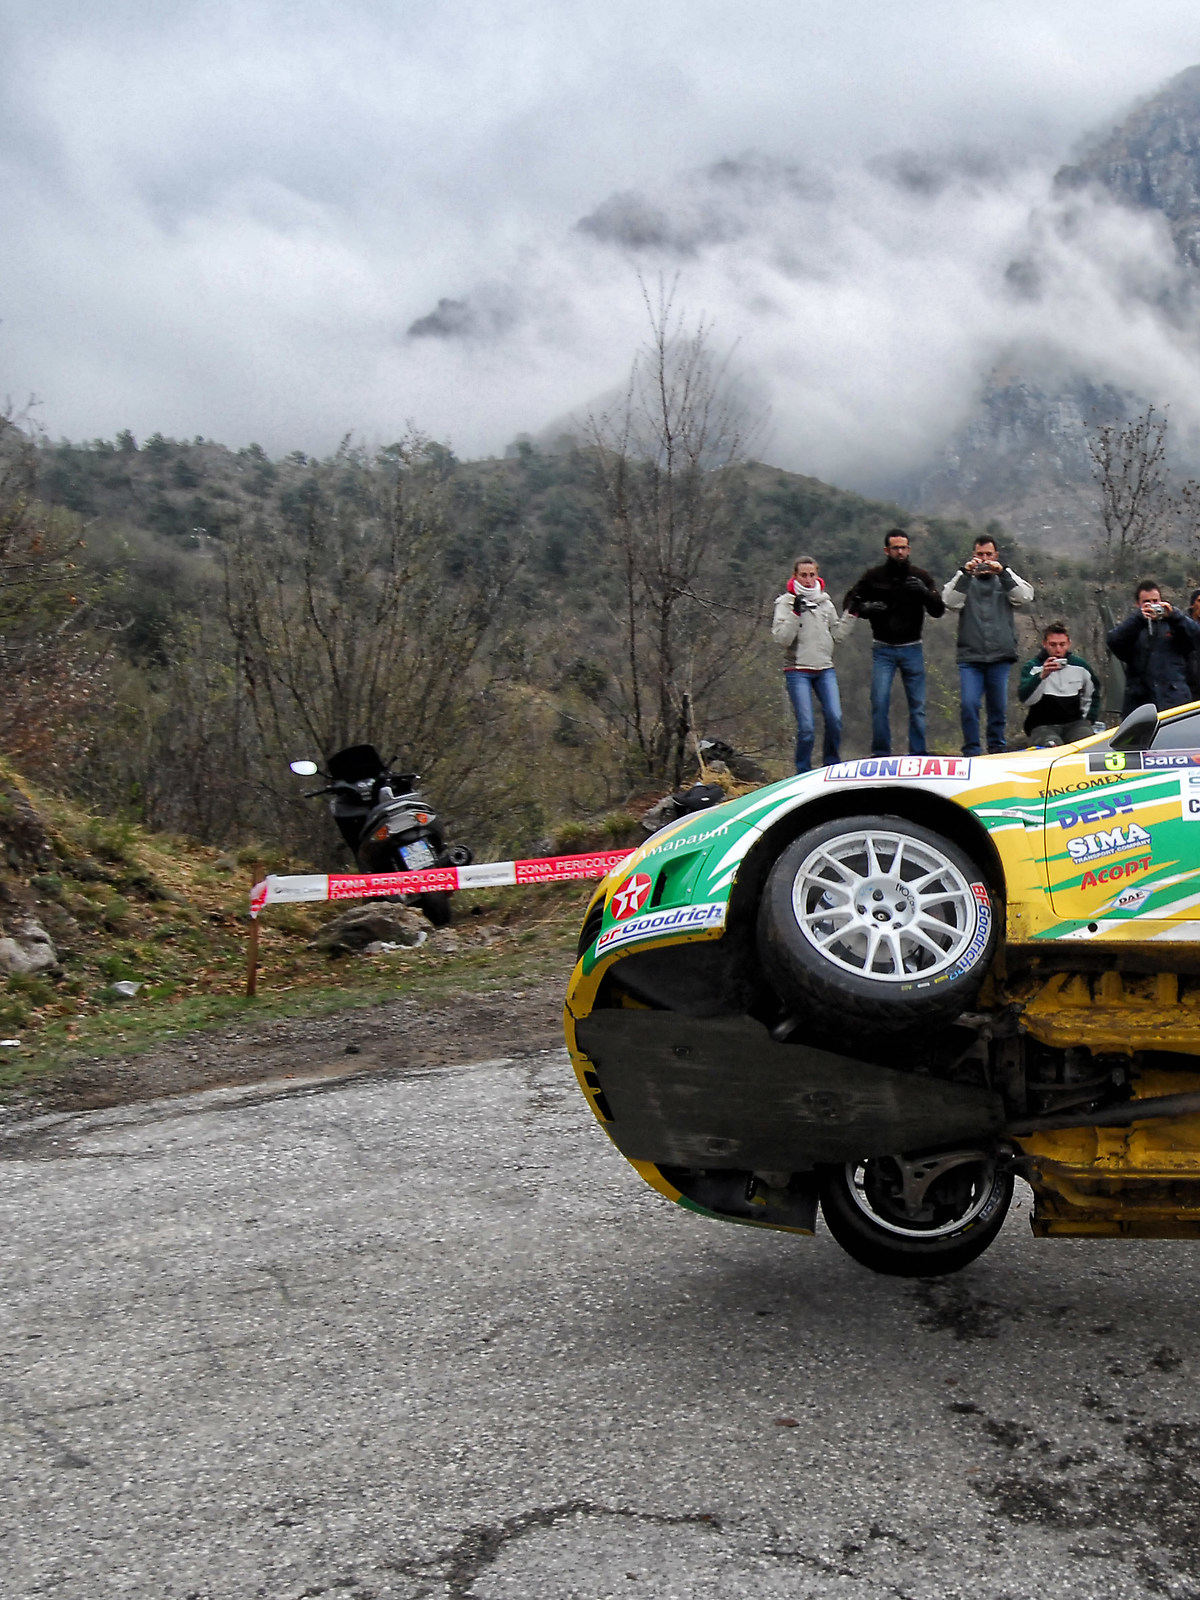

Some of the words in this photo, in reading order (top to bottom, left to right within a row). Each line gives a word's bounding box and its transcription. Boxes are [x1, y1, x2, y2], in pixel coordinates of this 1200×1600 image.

[1104, 752, 1127, 770] 3
[1145, 754, 1189, 766] sara
[1039, 773, 1126, 798] FINCOMEX
[1067, 822, 1152, 858] SIMA
[1072, 849, 1116, 865] TRANSPORT
[1117, 838, 1152, 853] COMPANY
[517, 863, 553, 875] ZONA
[556, 855, 629, 871] PERICOLOS
[330, 879, 367, 891] ZONA
[371, 872, 455, 886] PERICOLOSA
